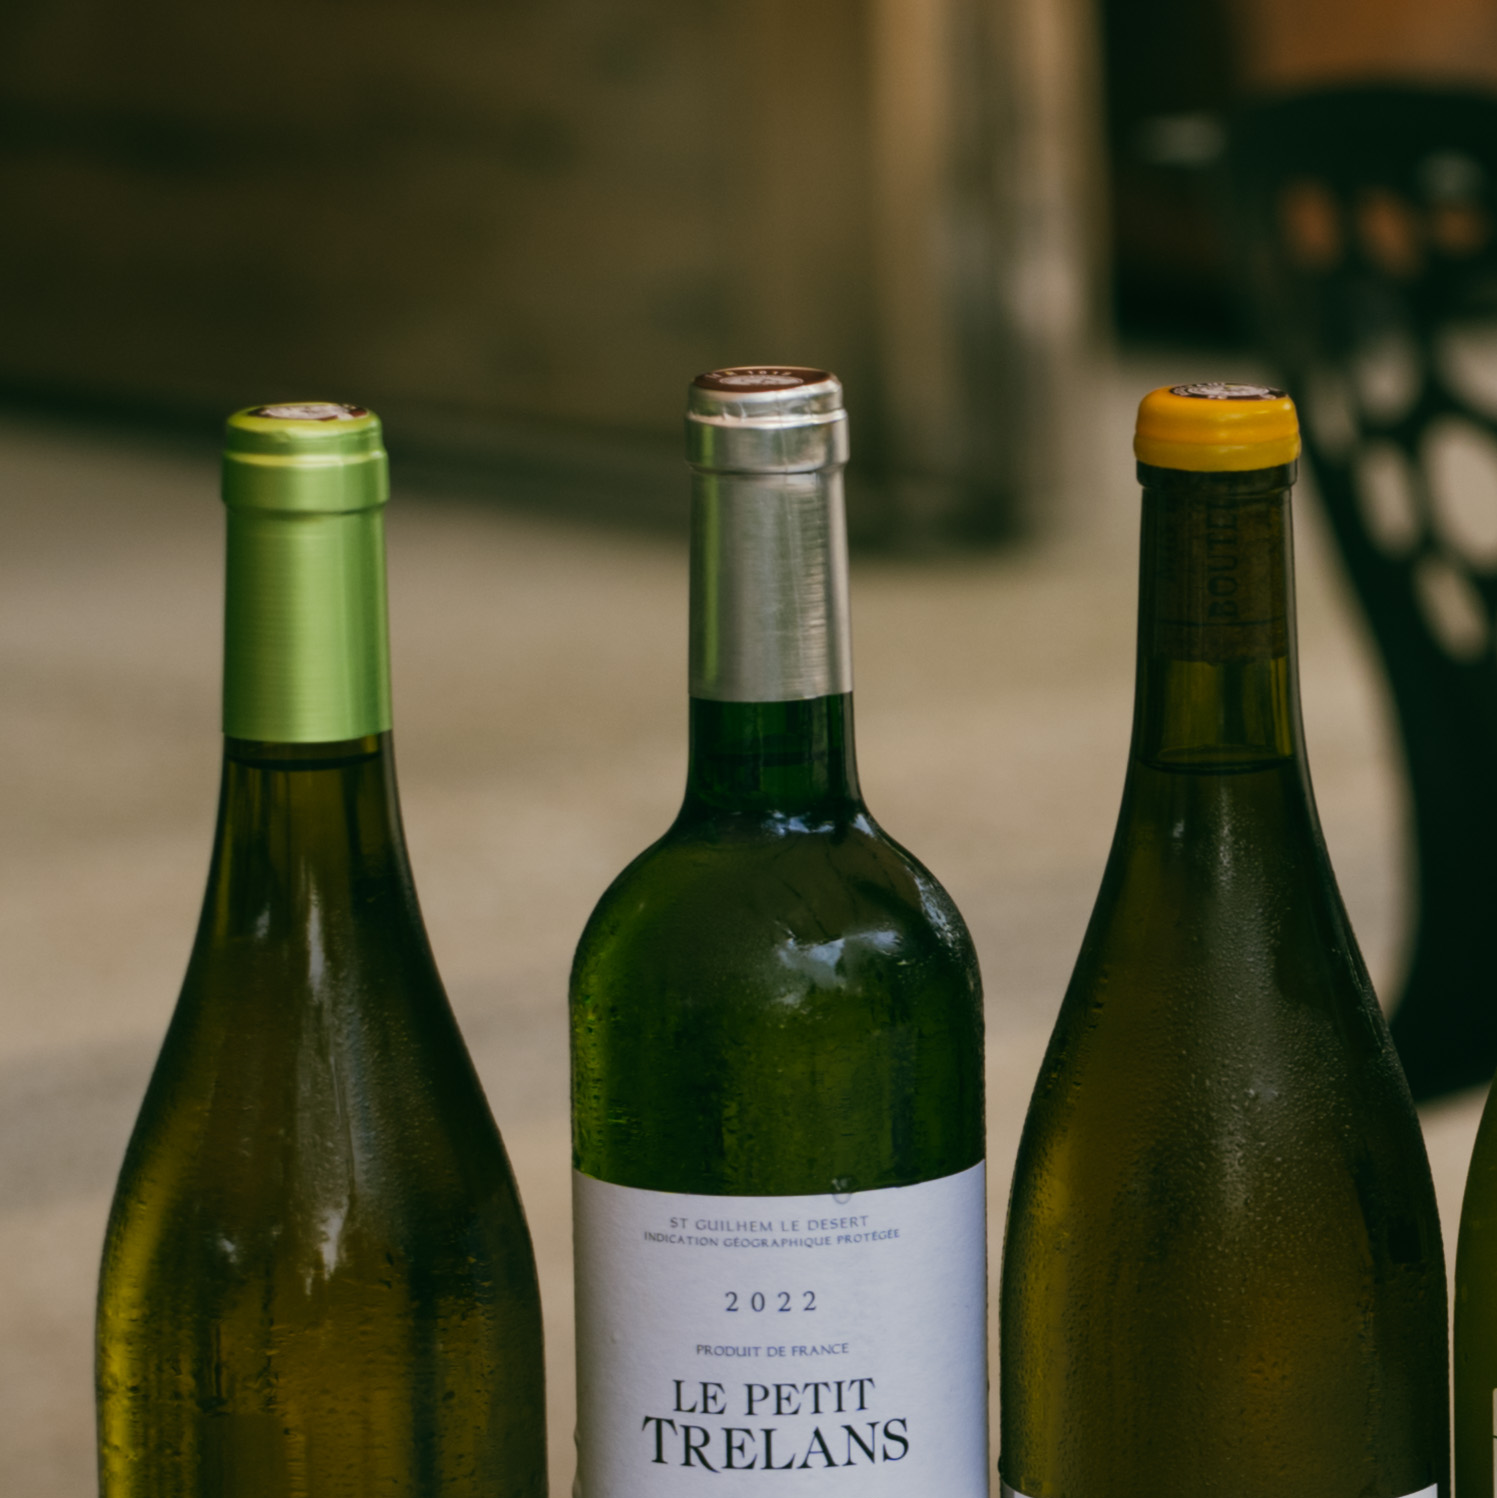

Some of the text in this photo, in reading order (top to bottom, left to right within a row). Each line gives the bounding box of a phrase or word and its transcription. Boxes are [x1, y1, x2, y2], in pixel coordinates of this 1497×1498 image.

[669, 1215, 870, 1232] ST GUILHEM LE DESERT
[643, 1227, 900, 1249] INDICATION GÉOGRAPHIQUE PROTÉGÉE
[724, 1291, 817, 1313] 2022
[696, 1342, 850, 1358] PRODUIT DE FRANCE
[672, 1378, 875, 1416] LE PETIT
[641, 1416, 910, 1473] TRELANS
